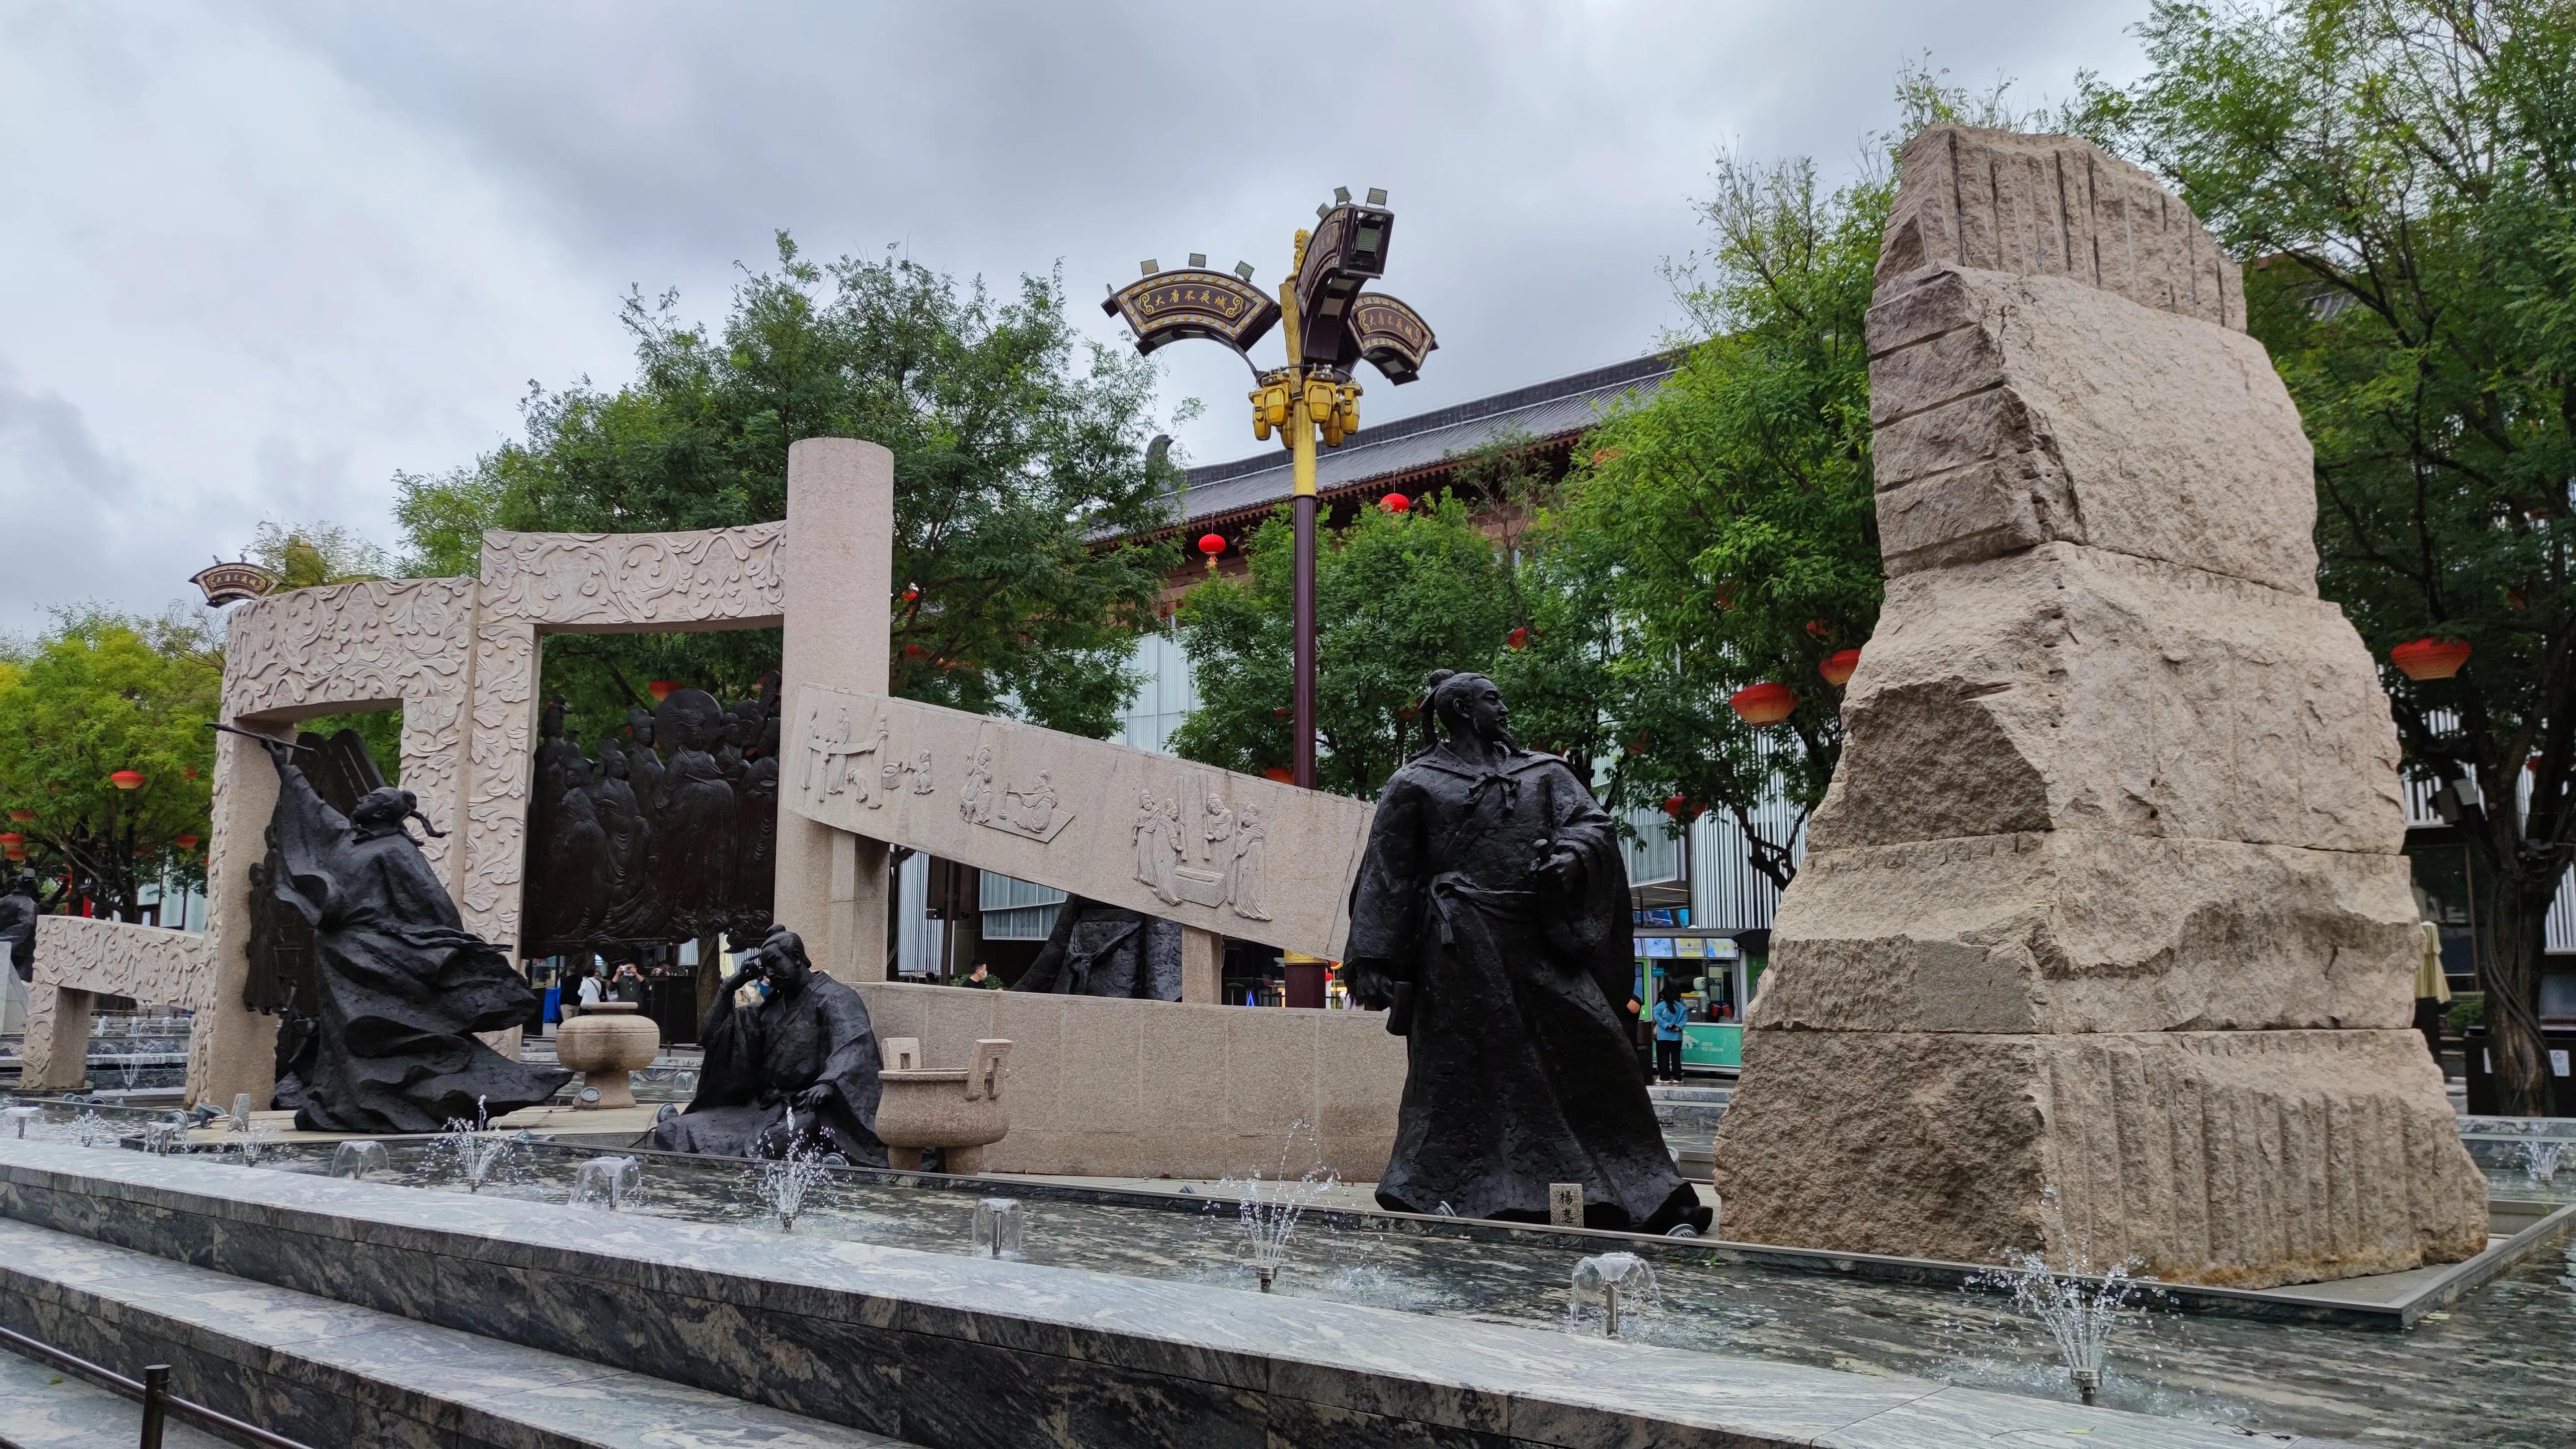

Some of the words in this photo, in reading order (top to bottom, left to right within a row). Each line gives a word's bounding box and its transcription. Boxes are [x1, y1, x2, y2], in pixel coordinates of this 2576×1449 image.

[1156, 289, 1227, 310] 大唐不夜城
